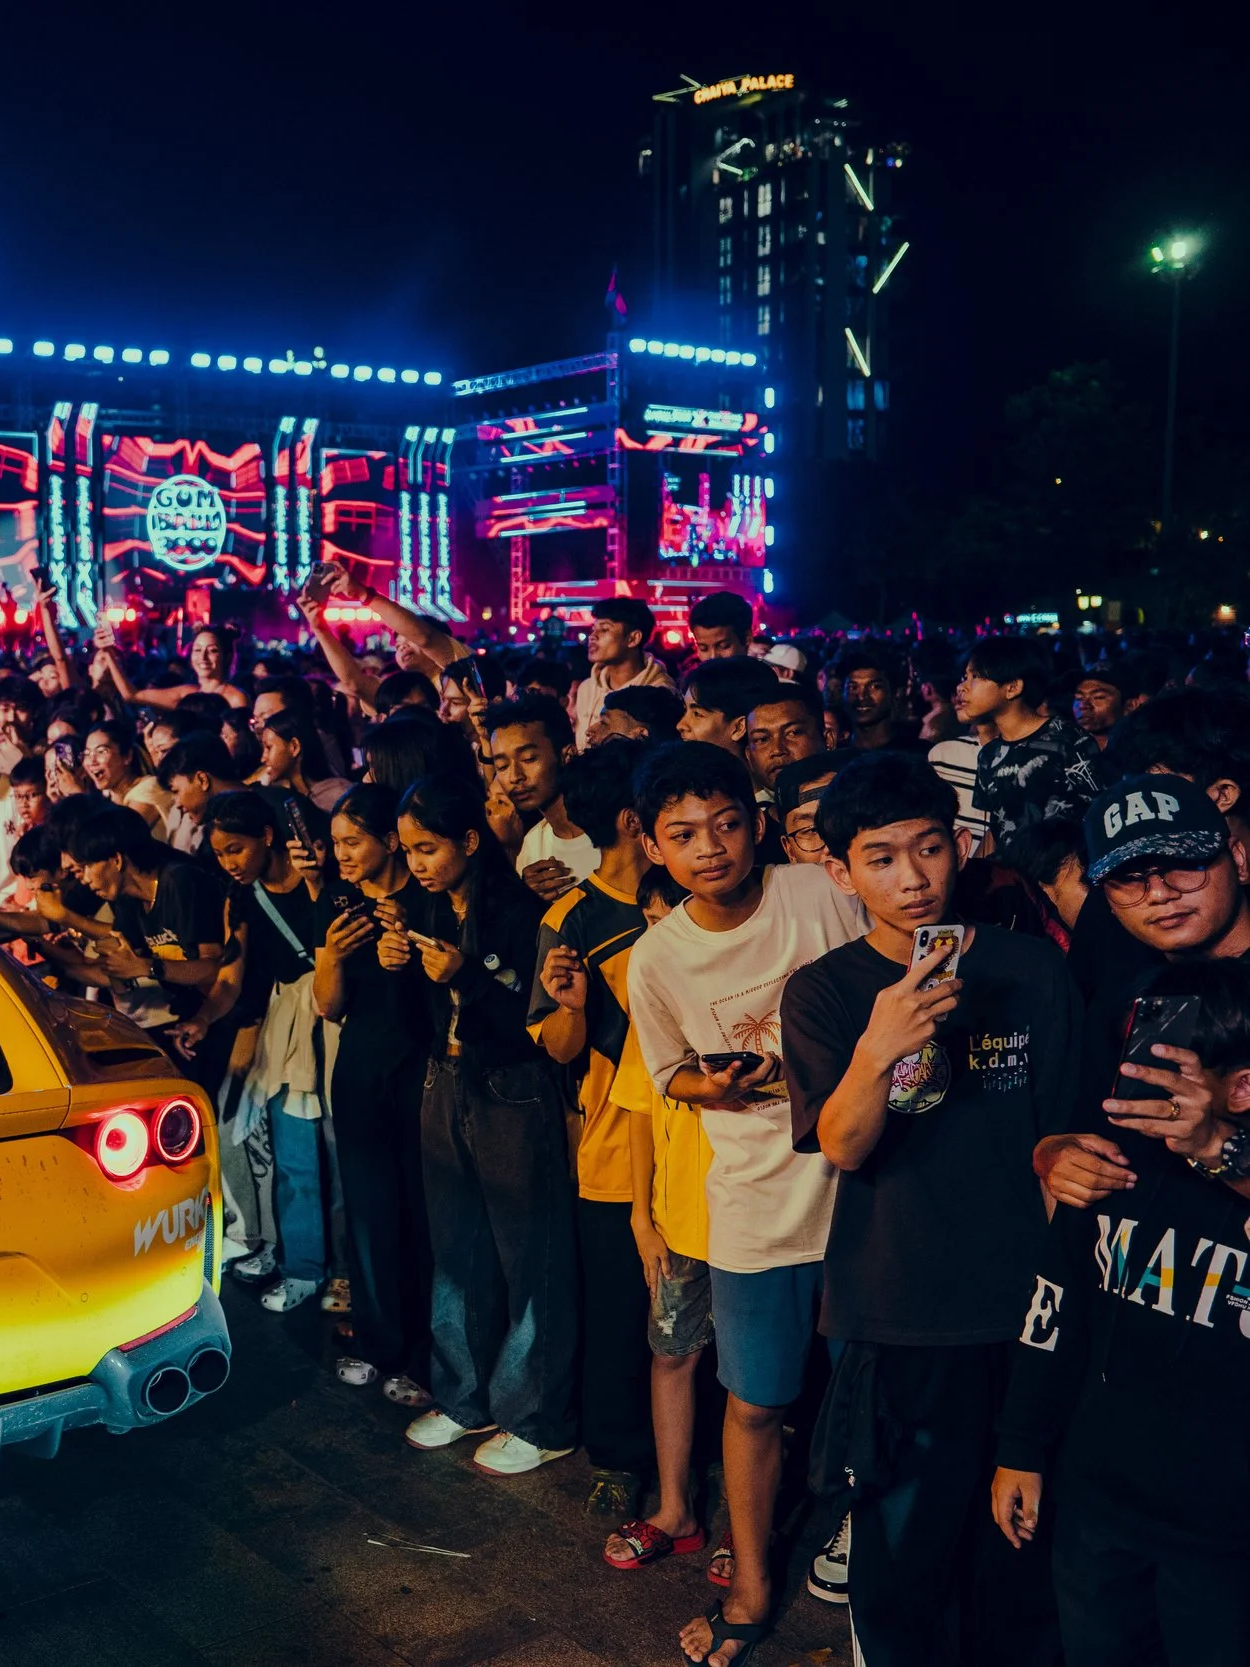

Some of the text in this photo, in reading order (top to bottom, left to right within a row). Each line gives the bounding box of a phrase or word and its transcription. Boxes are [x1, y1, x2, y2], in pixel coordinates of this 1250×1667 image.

[741, 74, 794, 91] PALACE
[1104, 791, 1180, 838] GAP
[1094, 1214, 1250, 1340] MAT
[1019, 1274, 1064, 1351] E
